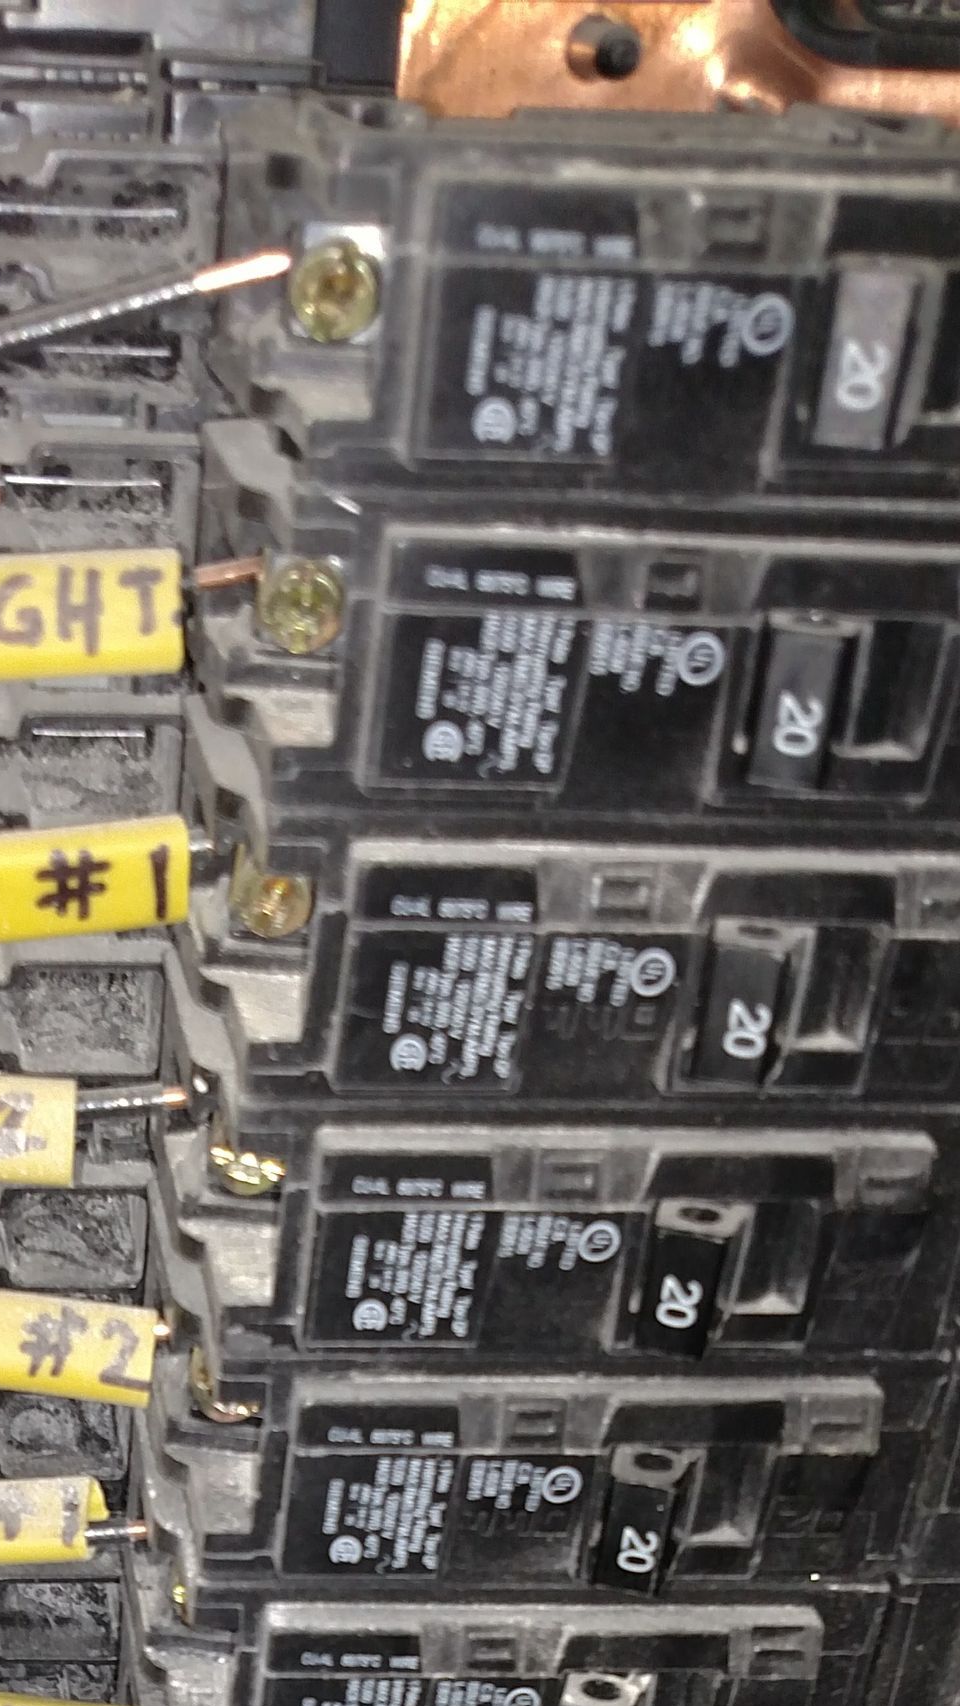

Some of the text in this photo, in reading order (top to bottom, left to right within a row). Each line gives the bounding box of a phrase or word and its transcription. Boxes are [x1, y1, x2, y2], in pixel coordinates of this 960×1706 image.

[838, 340, 887, 412] 20
[772, 685, 825, 757] 20
[721, 998, 775, 1061] 20
[655, 1273, 703, 1330] 20
[18, 1305, 152, 1389] #2
[615, 1525, 659, 1574] 20
